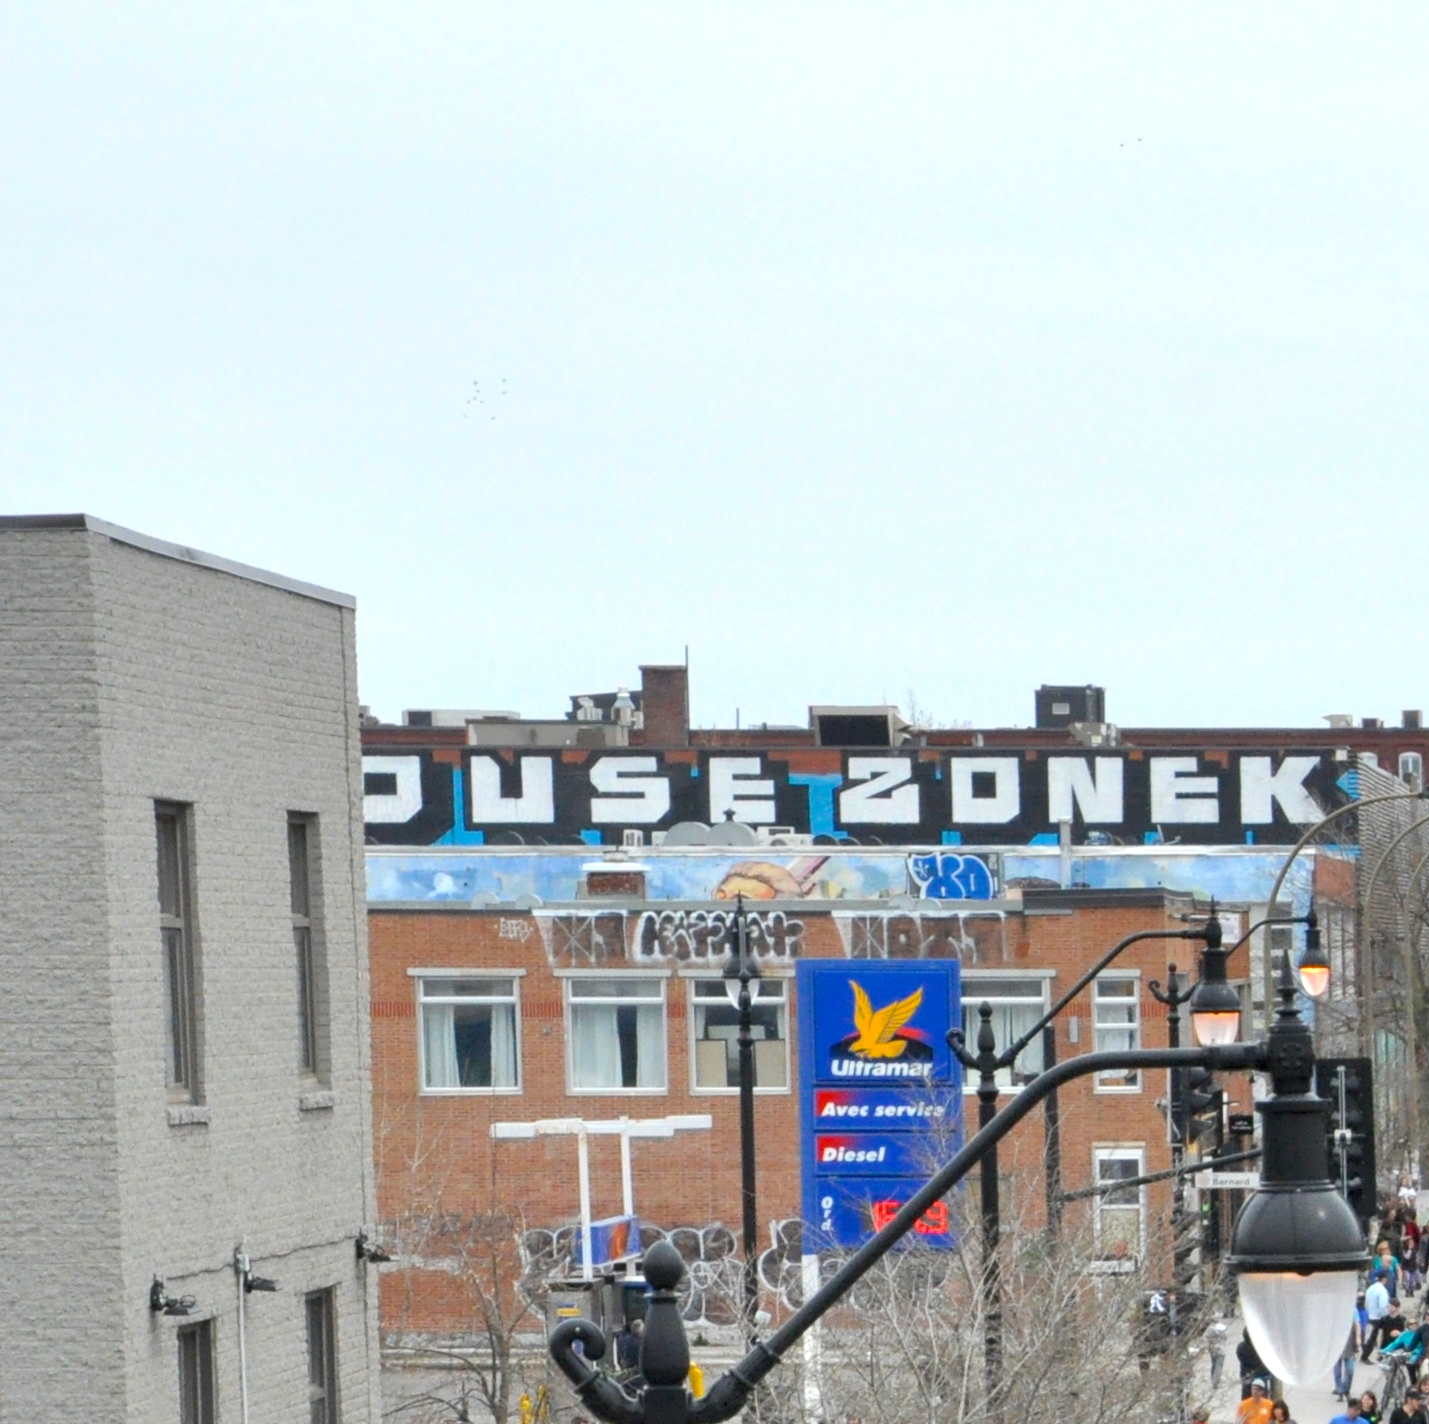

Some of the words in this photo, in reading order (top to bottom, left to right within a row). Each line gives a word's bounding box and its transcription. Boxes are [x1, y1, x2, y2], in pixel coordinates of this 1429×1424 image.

[839, 755, 1327, 826] ZONEK
[831, 1058, 934, 1078] Ultramar
[821, 1099, 869, 1119] Avec
[822, 1145, 887, 1163] Diesel
[1212, 1178, 1251, 1187] Bernard
